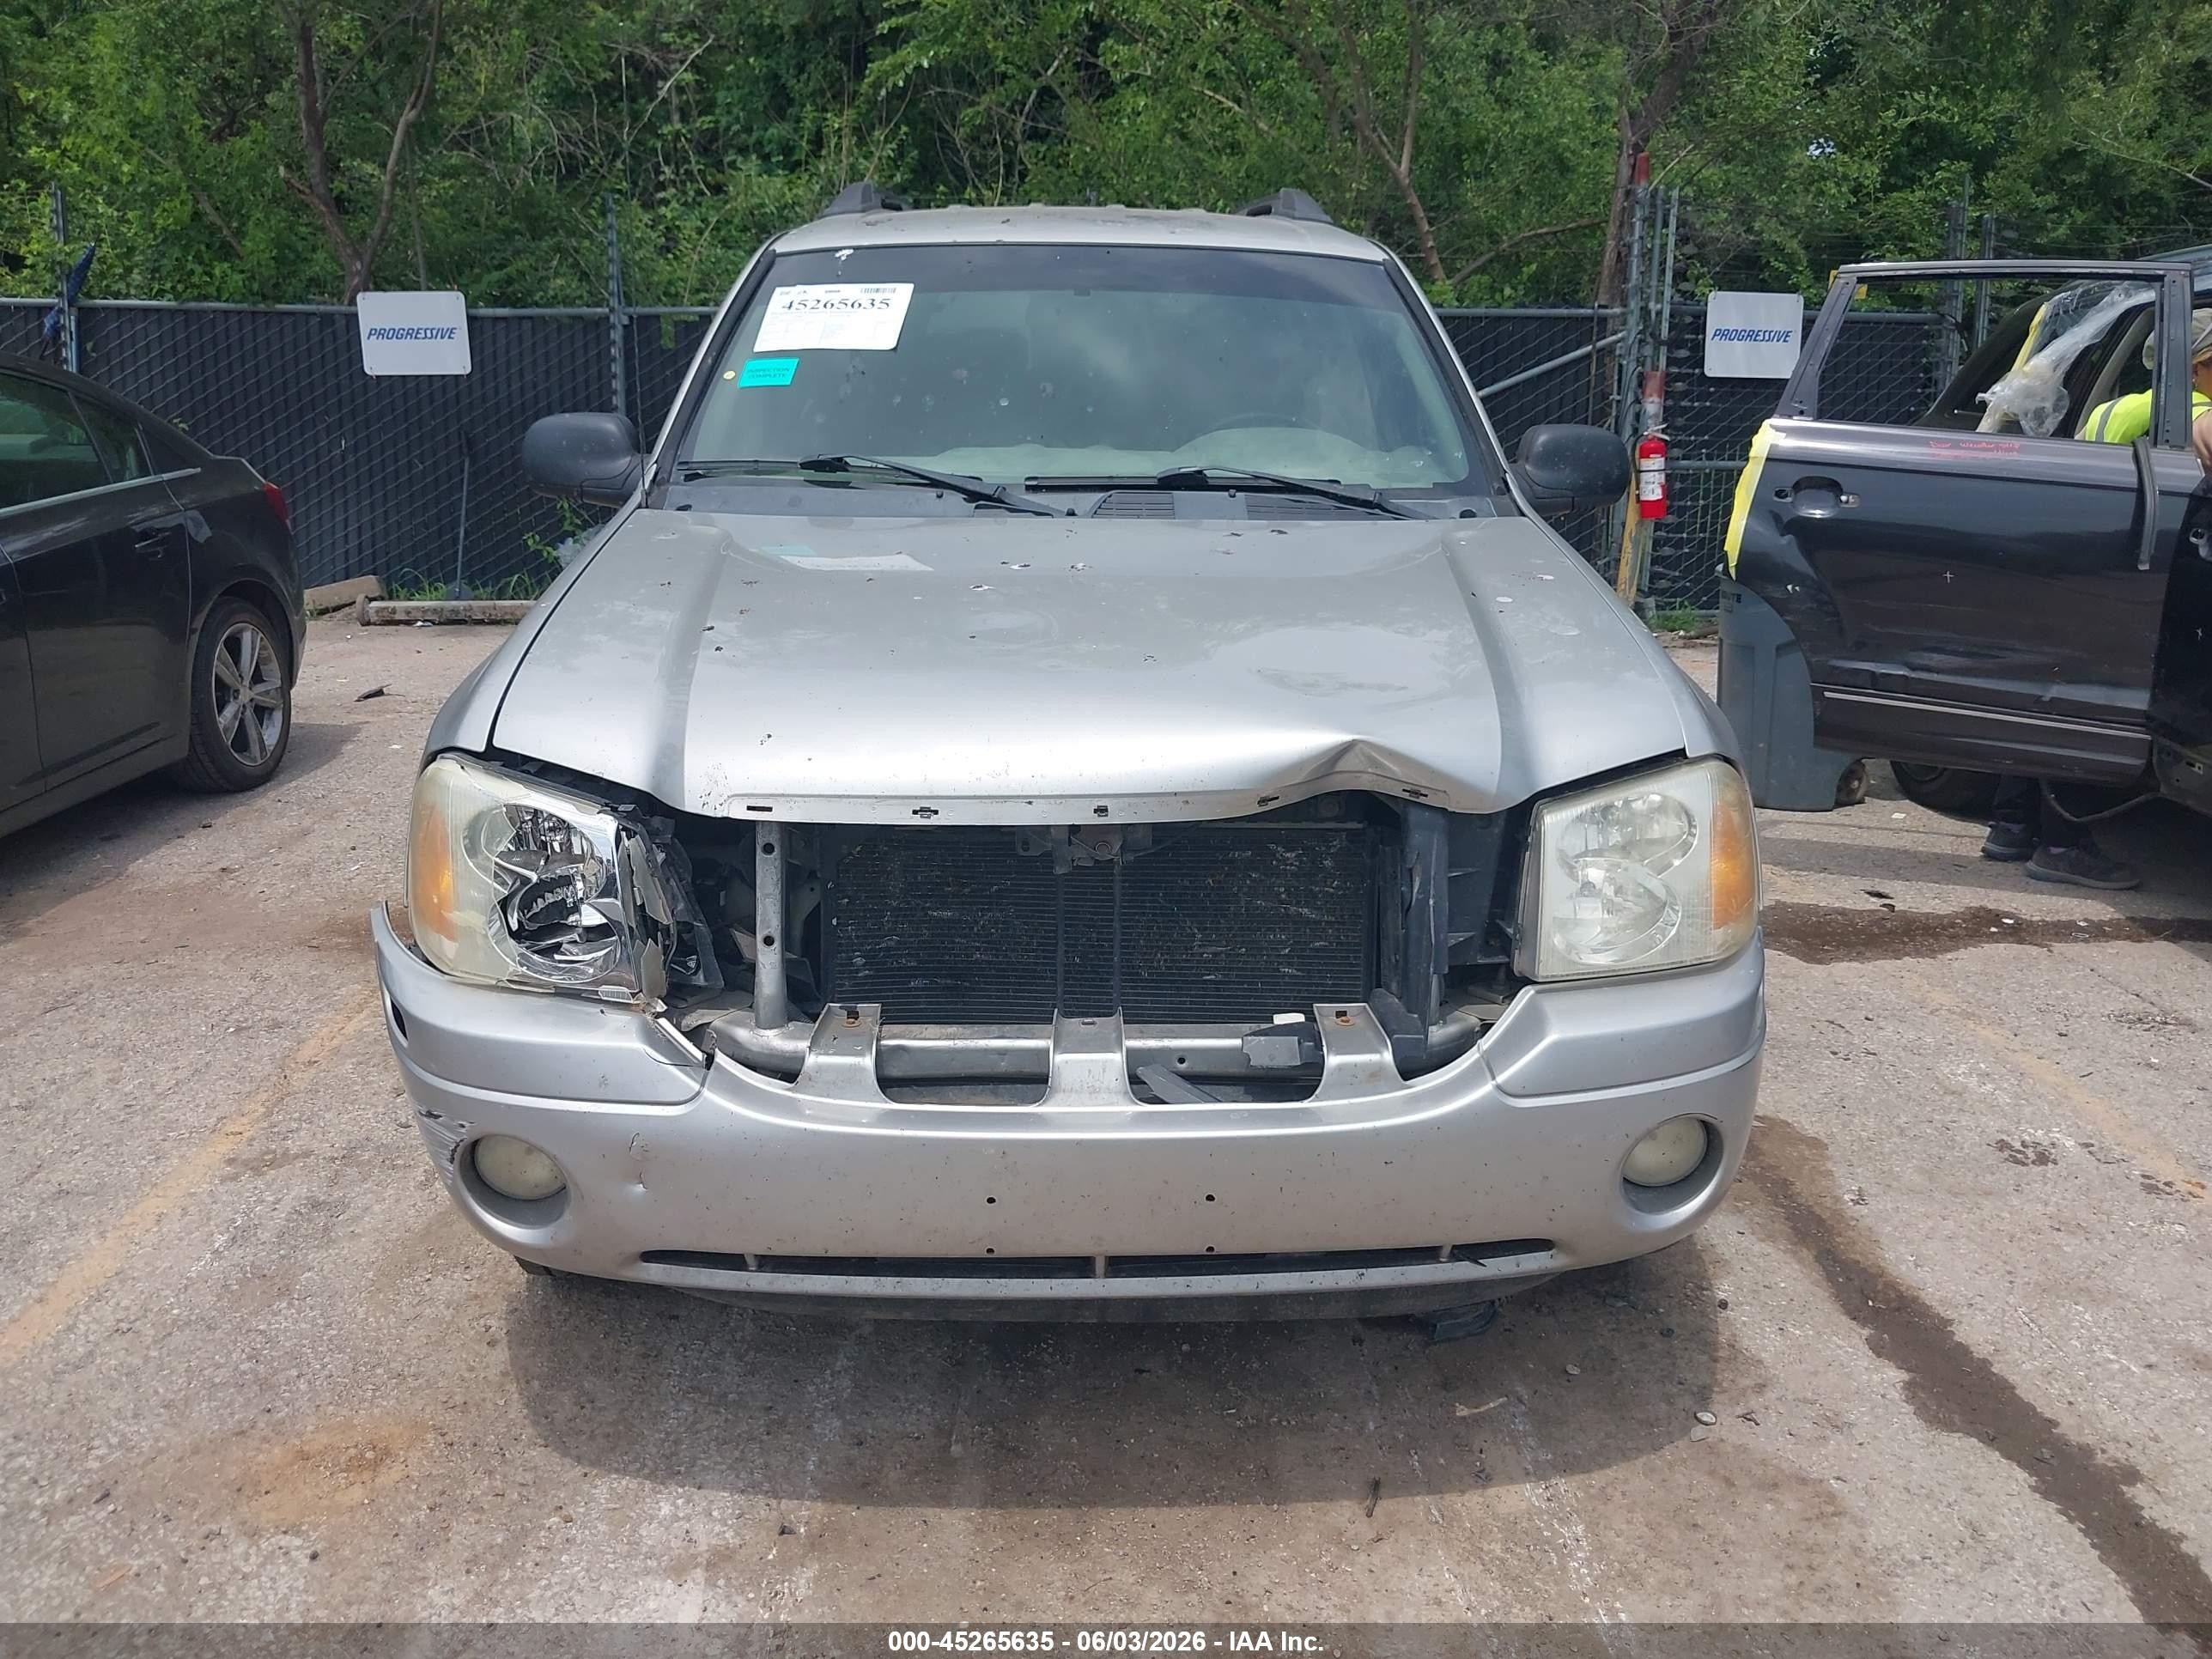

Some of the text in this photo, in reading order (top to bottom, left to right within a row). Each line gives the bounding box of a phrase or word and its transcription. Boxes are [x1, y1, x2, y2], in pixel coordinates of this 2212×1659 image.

[781, 298, 893, 311] 45265635
[367, 327, 457, 340] PROGRESSIVE
[1711, 328, 1793, 343] PROGRESSIVE
